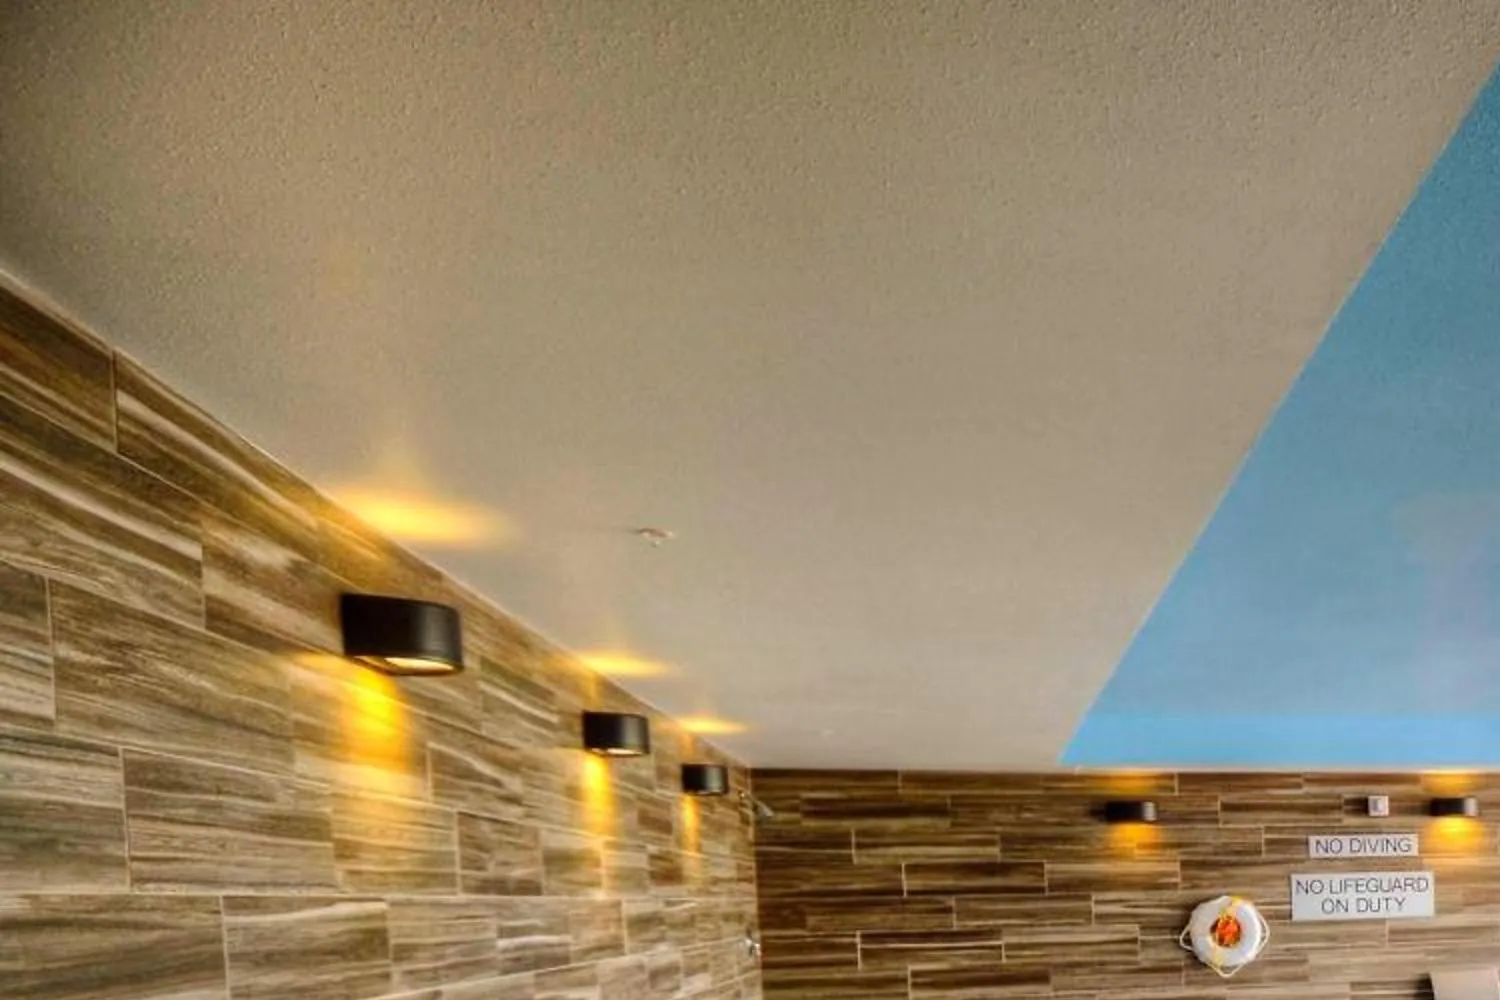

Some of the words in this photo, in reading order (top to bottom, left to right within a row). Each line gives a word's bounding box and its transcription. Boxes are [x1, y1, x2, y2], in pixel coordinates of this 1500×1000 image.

[1315, 839, 1343, 854] NO
[1349, 838, 1412, 853] DIVING
[1295, 879, 1324, 895] NO
[1329, 878, 1429, 894] LIFEGUARD
[1321, 898, 1349, 914] ON
[1356, 897, 1406, 913] DUTY
